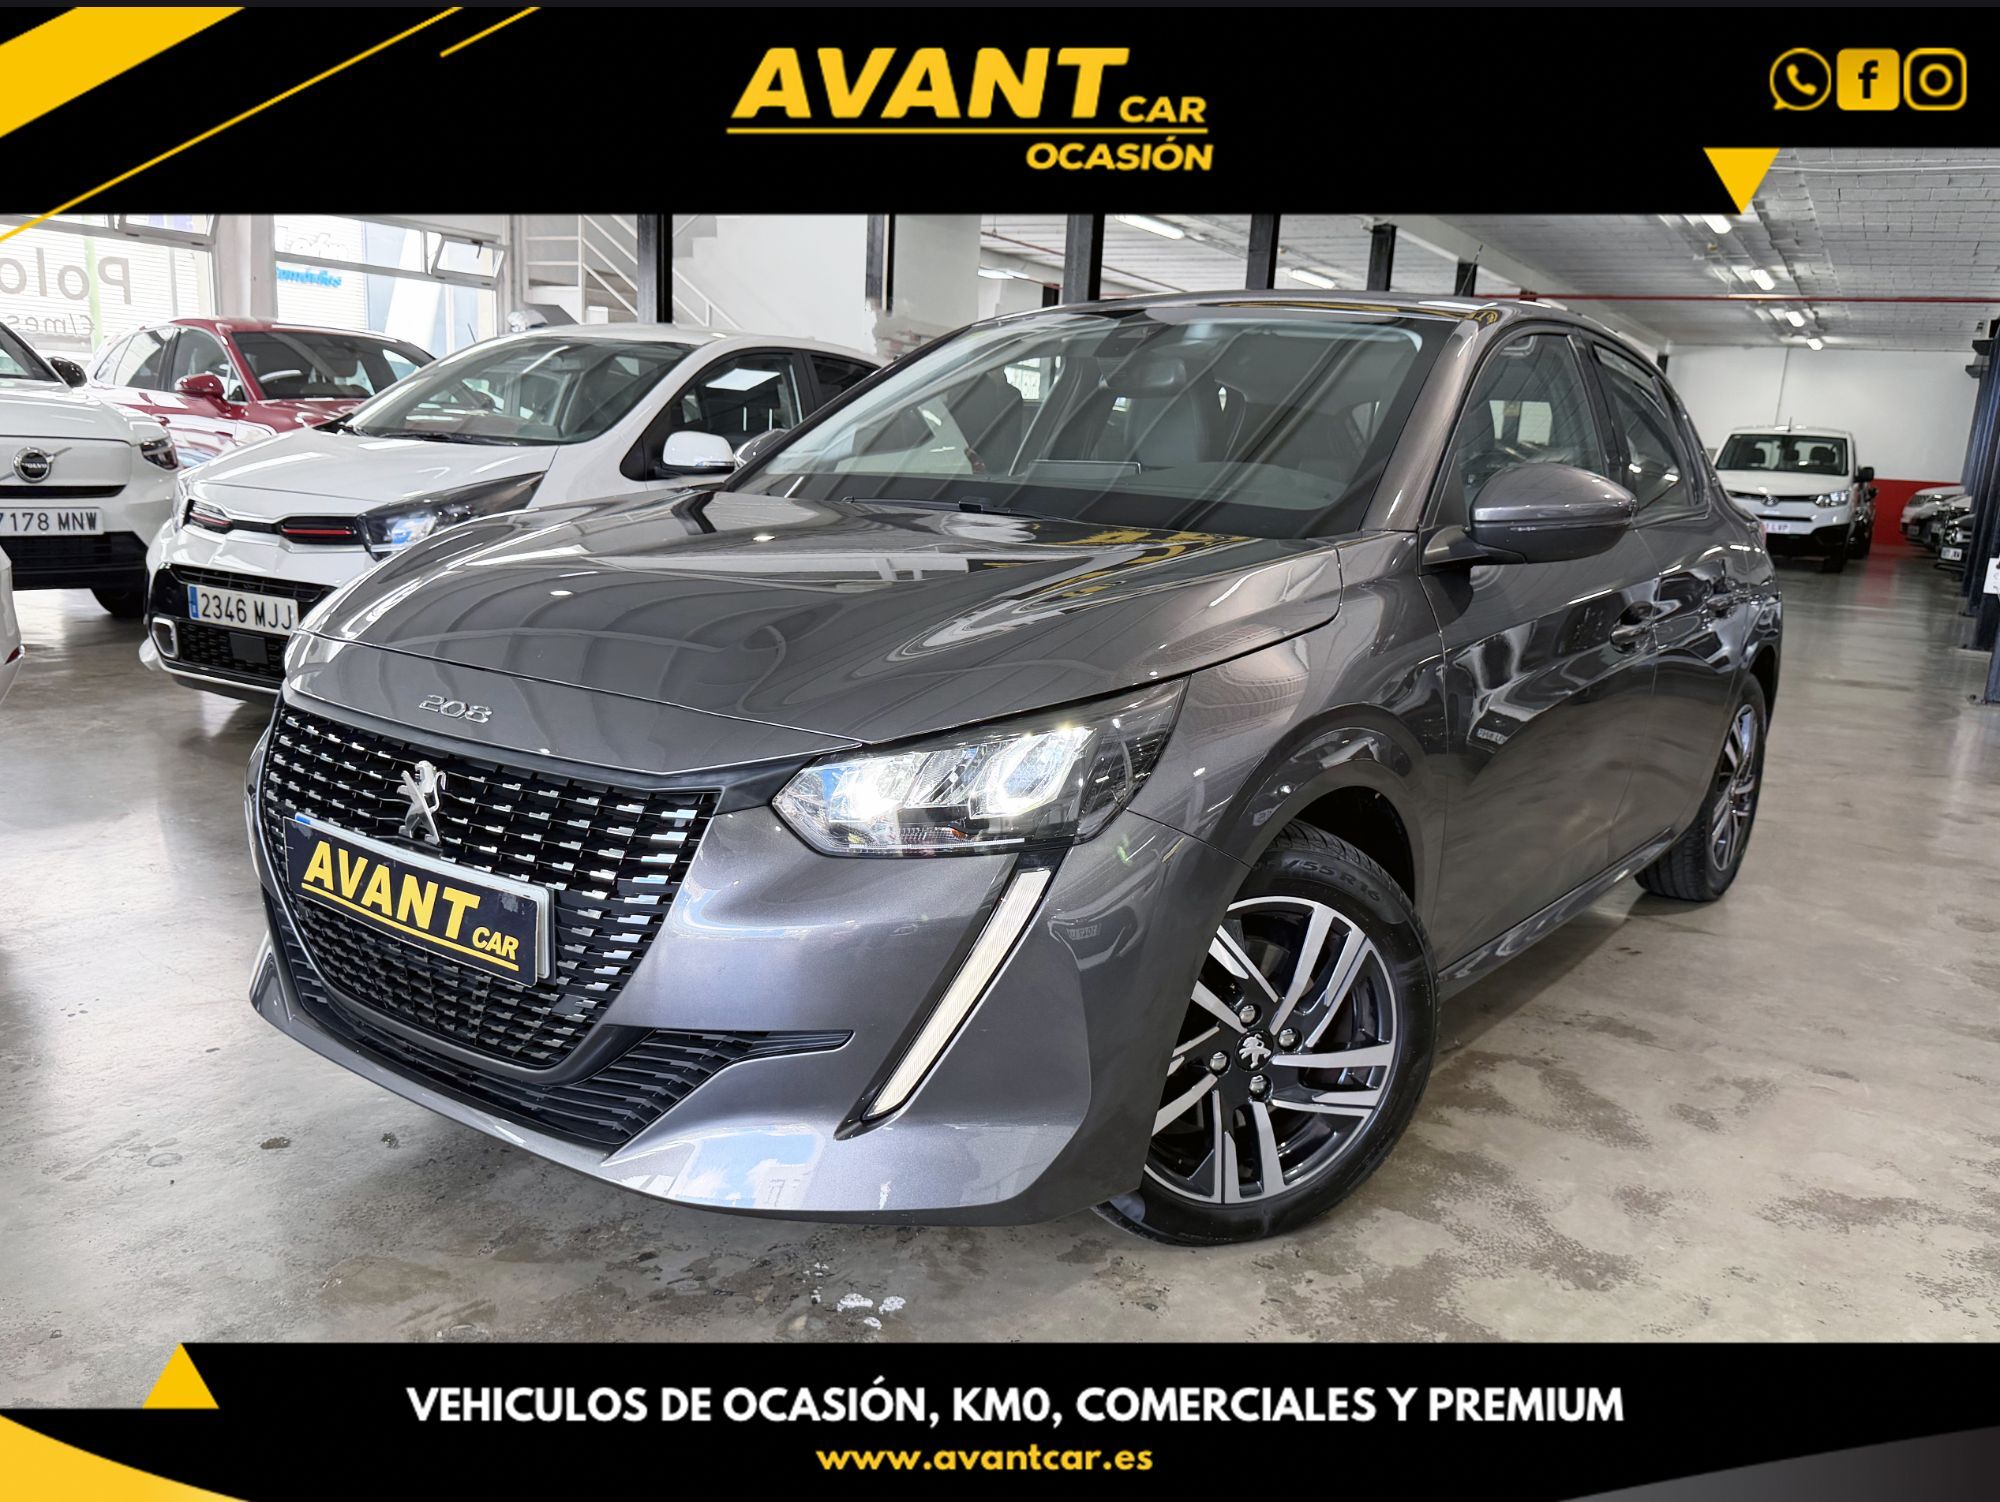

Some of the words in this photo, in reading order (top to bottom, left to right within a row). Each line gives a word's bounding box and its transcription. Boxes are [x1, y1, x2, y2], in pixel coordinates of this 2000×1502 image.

[57, 512, 97, 531] MNW
[201, 593, 247, 623] 2346
[254, 600, 292, 629] MJJ
[419, 694, 492, 723] 208
[303, 840, 480, 940] AVANT
[472, 926, 520, 961] CAR
